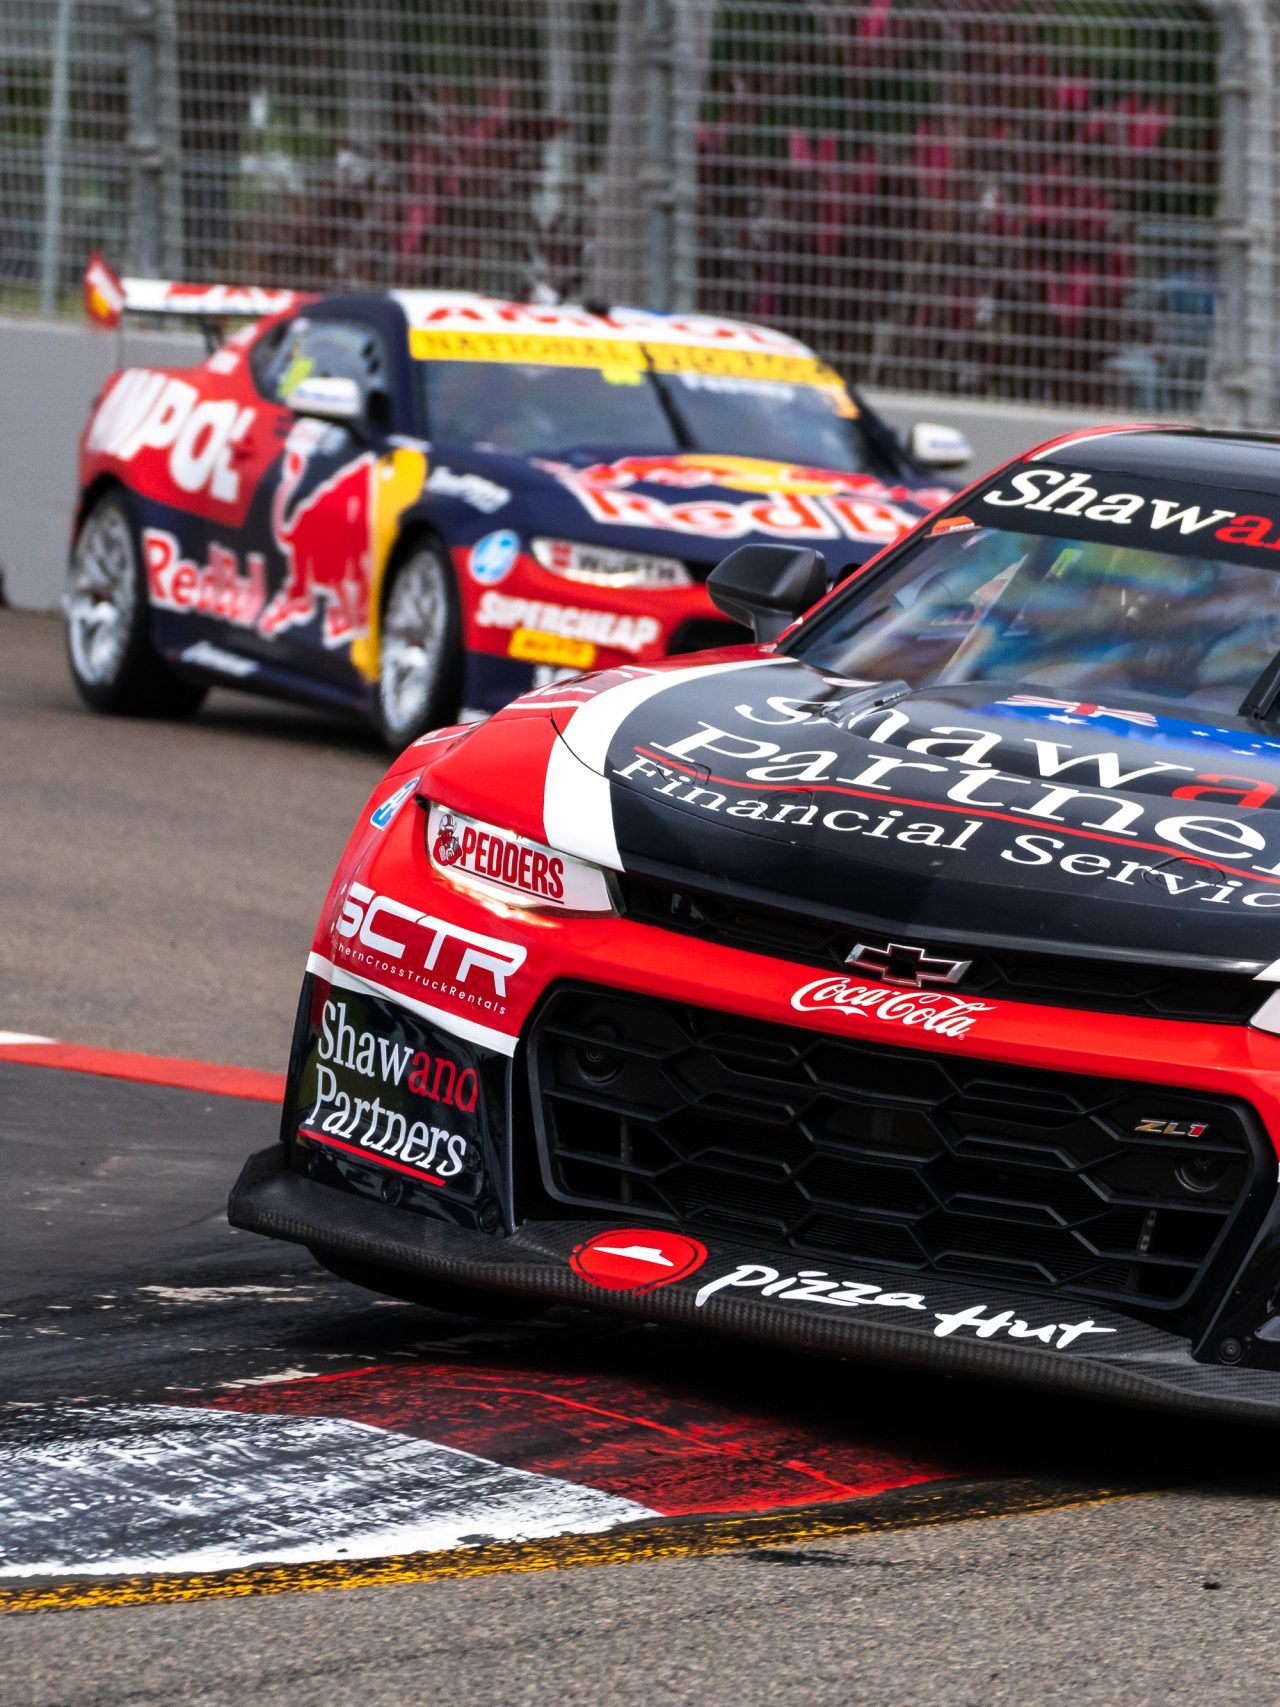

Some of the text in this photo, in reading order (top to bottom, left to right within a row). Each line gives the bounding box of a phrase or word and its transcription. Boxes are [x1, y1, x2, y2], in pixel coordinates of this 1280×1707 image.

[476, 591, 661, 653] SUPERCHEAP
[612, 754, 984, 851] Financial
[460, 827, 565, 899] PEDDERS
[336, 881, 528, 998] SCTR
[790, 976, 998, 1039] Coca-Cola
[304, 1062, 467, 1177] Partners
[1134, 1118, 1209, 1138] ZL1
[695, 1263, 1117, 1350] Pizza Hut
